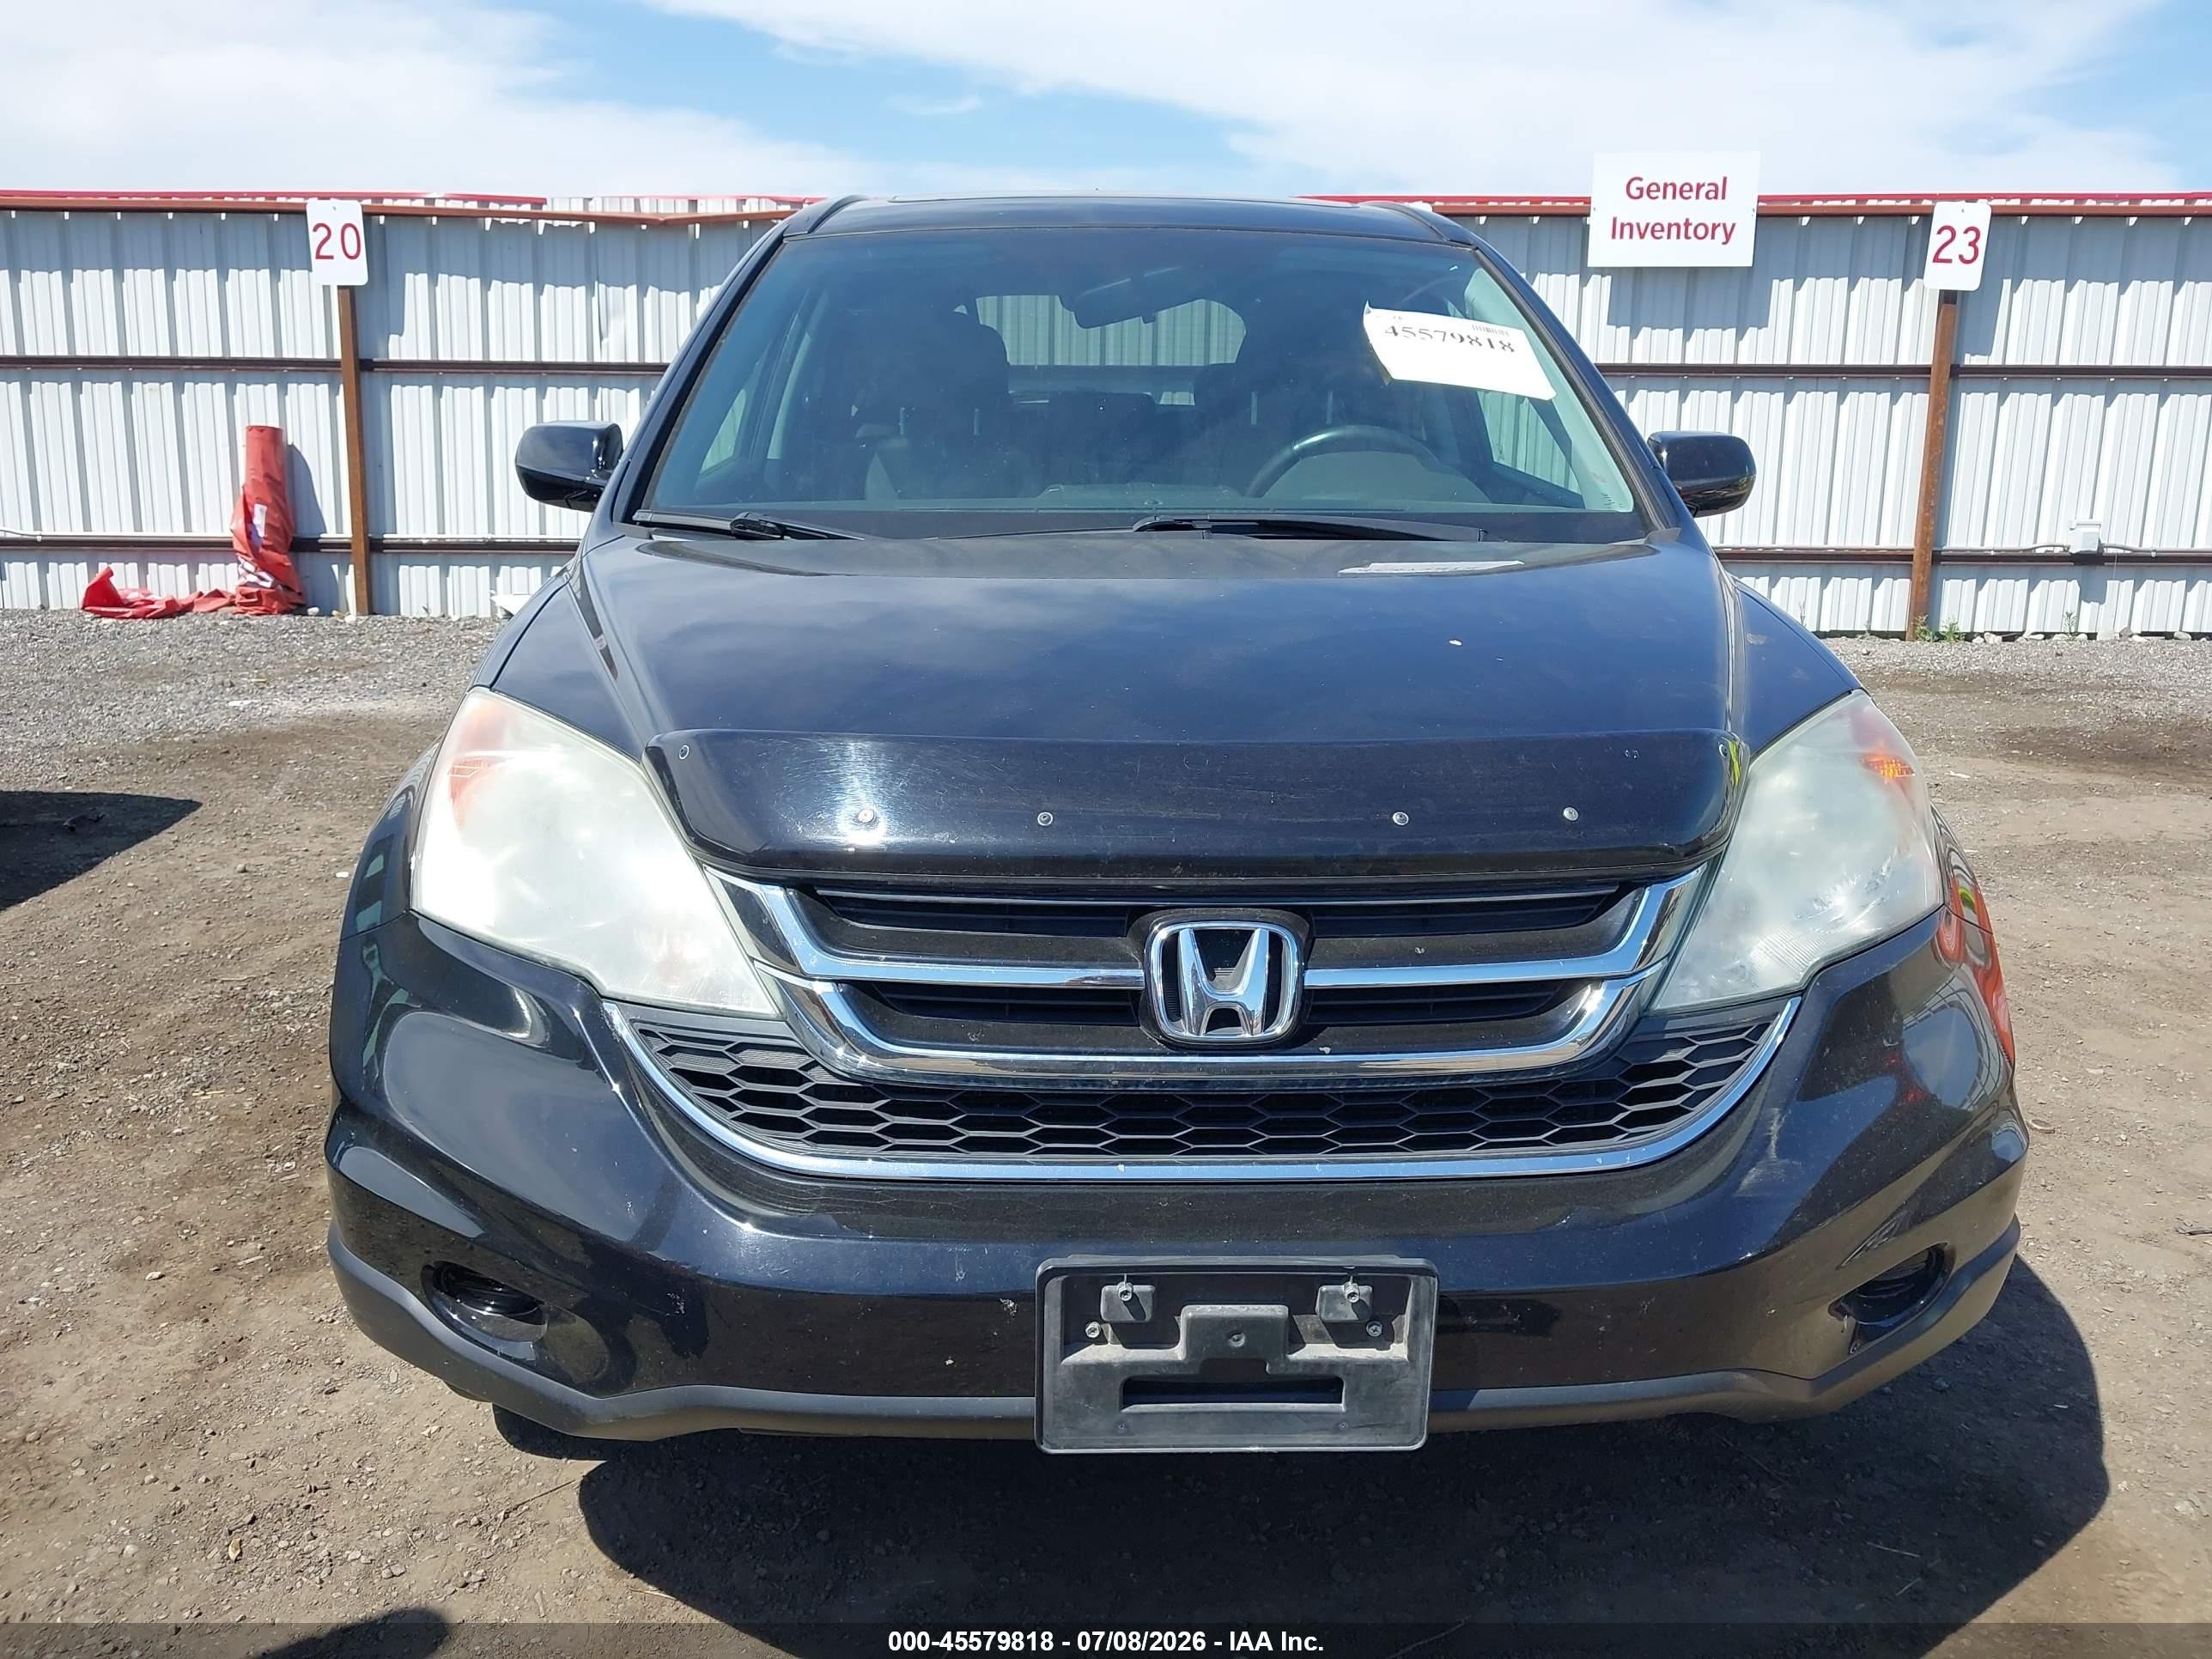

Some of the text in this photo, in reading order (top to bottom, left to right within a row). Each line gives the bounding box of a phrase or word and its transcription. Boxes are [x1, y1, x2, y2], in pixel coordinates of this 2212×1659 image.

[1625, 175, 1728, 201] General
[312, 222, 362, 260] 20
[1611, 216, 1736, 246] Inventory
[1932, 225, 1981, 264] 23
